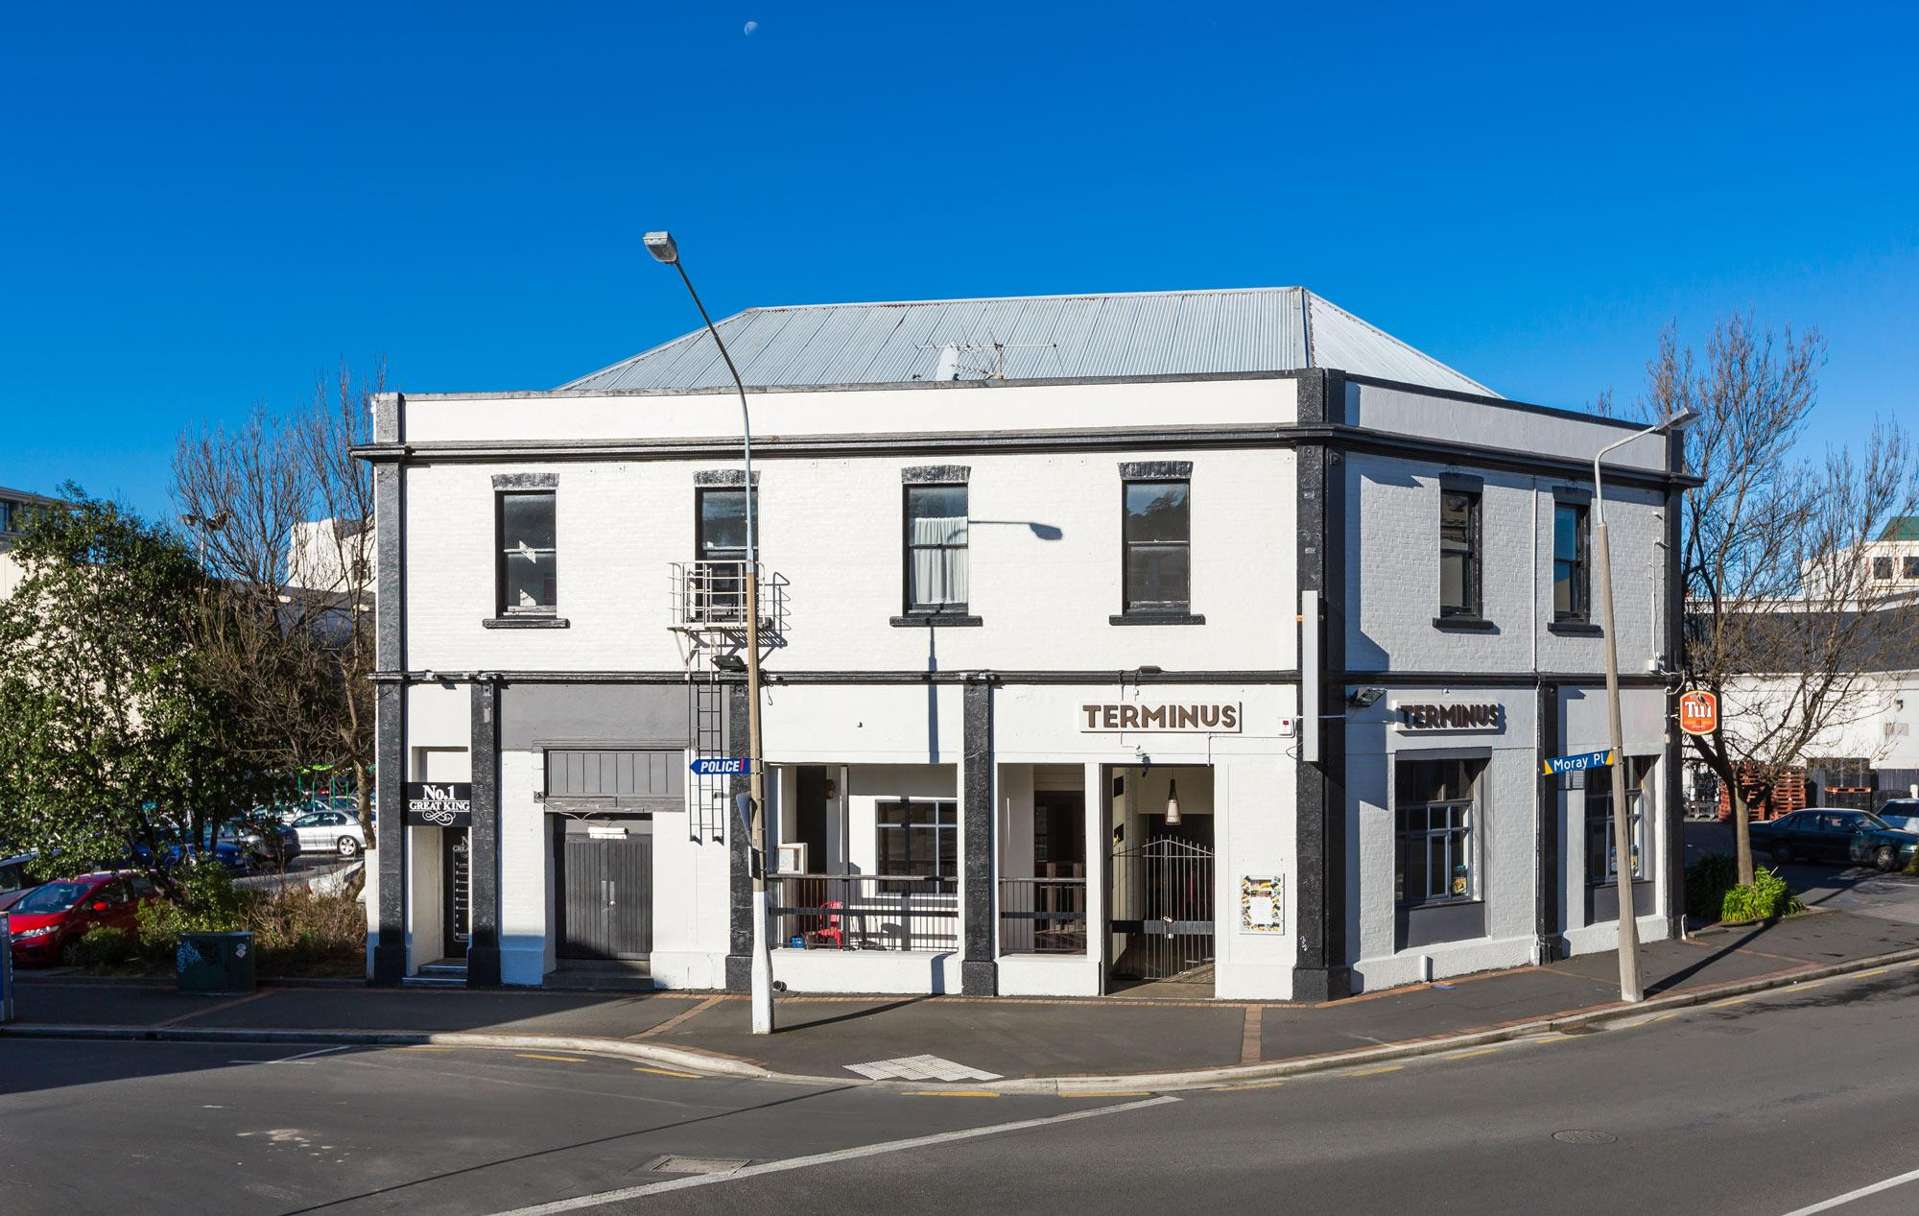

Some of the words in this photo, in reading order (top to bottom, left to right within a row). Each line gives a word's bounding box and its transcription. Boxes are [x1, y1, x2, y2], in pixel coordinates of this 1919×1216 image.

[1083, 704, 1237, 729] TERMINUS
[1401, 703, 1499, 729] TERMINUS
[1685, 701, 1712, 718] Tui
[701, 760, 741, 772] POLICE
[1553, 756, 1588, 772] Moray
[1593, 751, 1605, 766] Pl
[423, 784, 456, 800] No.1
[409, 801, 440, 810] GREAT
[443, 801, 470, 810] KING
